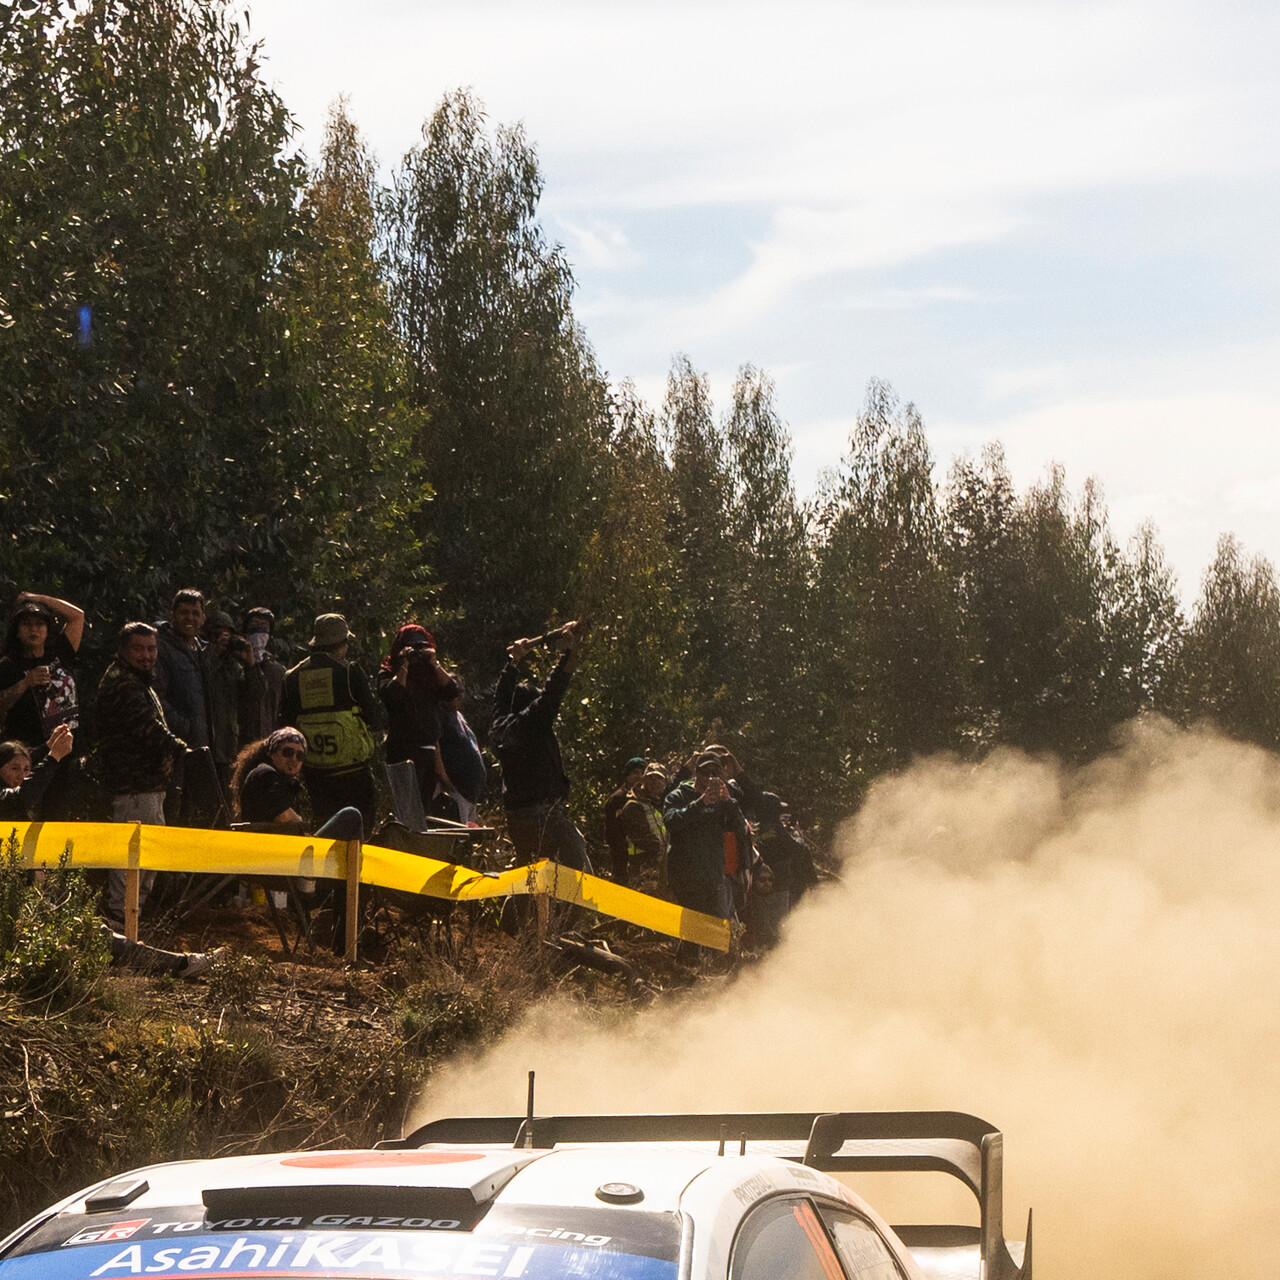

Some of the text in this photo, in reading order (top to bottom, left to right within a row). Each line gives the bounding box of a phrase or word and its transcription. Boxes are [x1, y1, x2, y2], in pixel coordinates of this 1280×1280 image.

[70, 1226, 136, 1244] GR
[152, 1216, 303, 1234] TOYOTA
[312, 1214, 461, 1229] GAZOO
